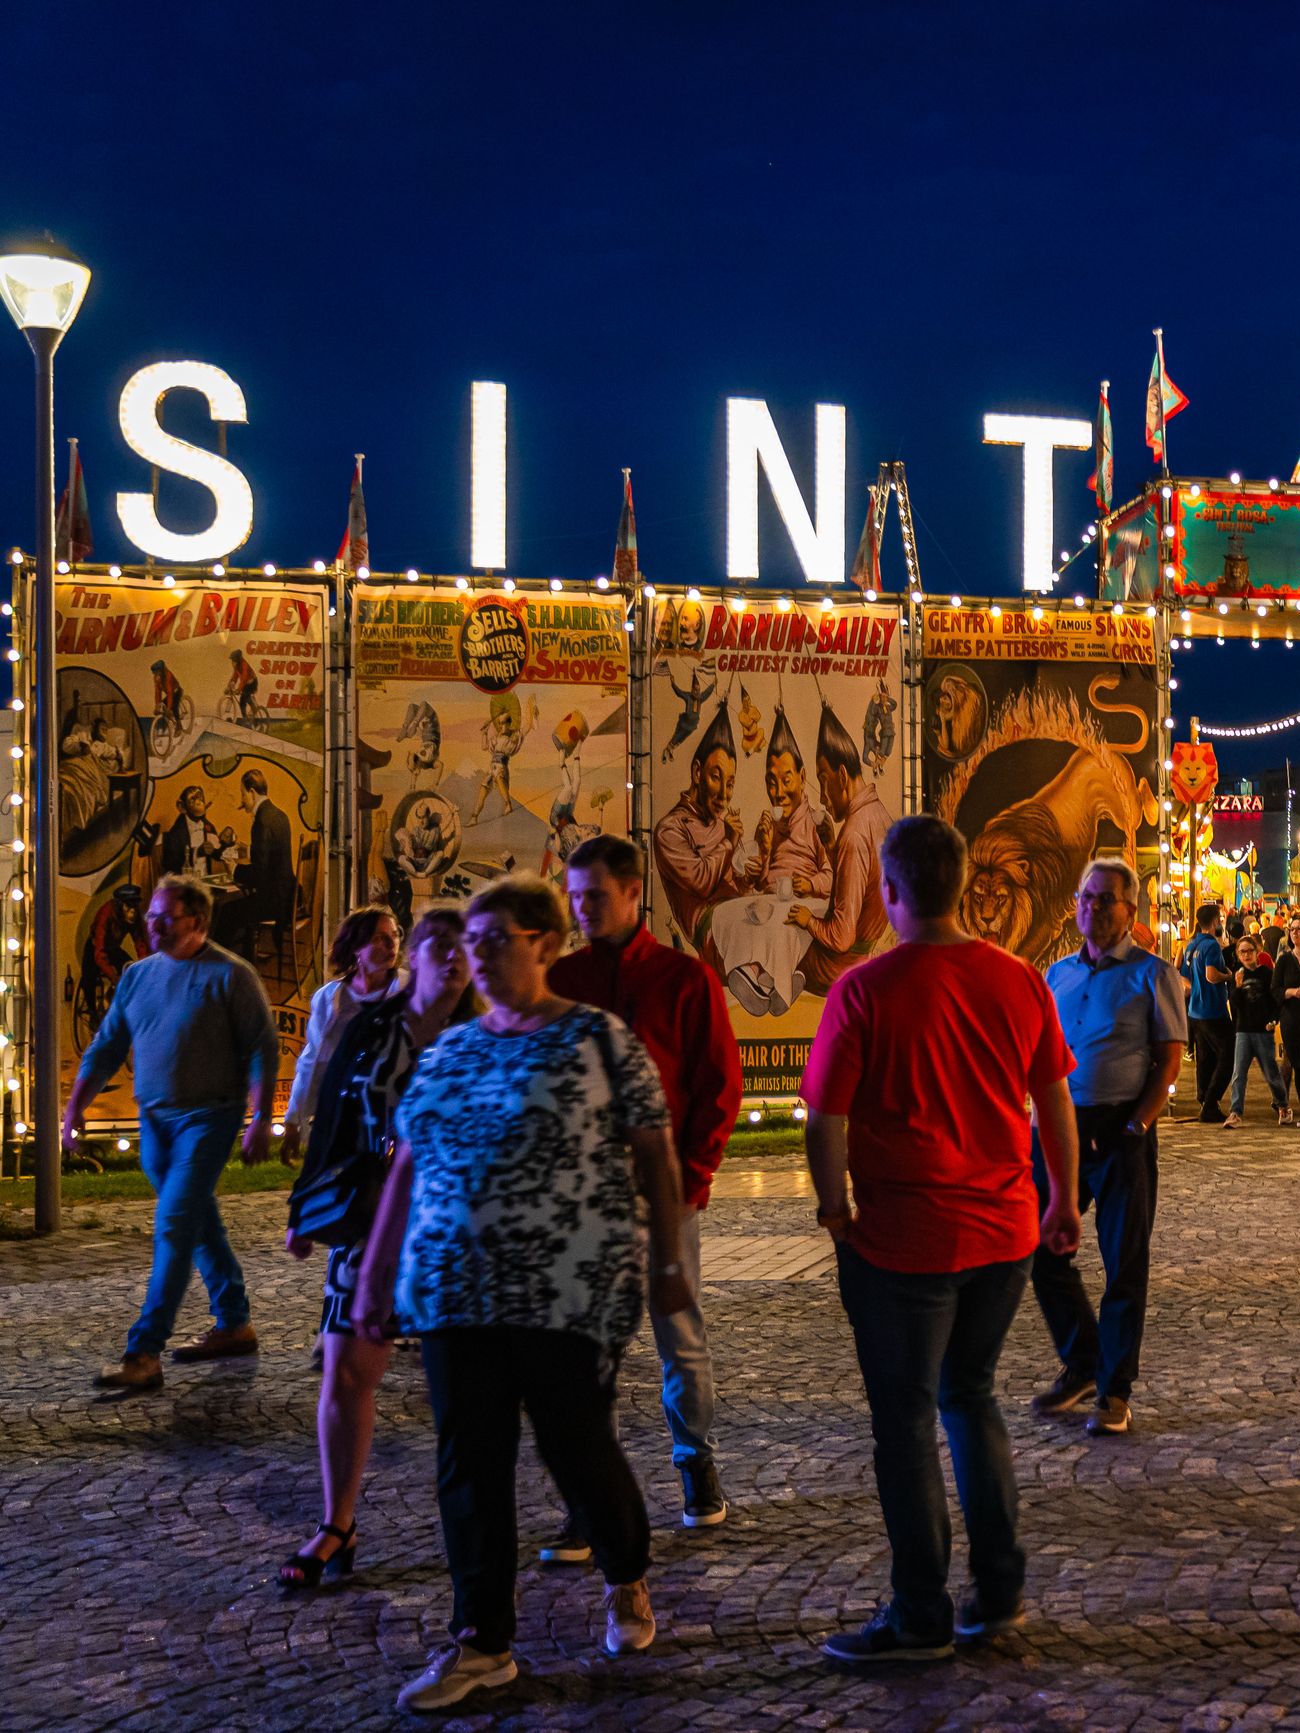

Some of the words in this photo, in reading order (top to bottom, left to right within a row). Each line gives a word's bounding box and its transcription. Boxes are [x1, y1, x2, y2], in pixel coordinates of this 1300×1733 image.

[117, 360, 1093, 592] SINT
[71, 586, 112, 609] THE
[193, 592, 318, 637] BAILEY
[467, 610, 518, 642] SELLS
[928, 611, 994, 634] GENTRY
[1002, 613, 1054, 635] BROS.
[1056, 618, 1092, 631] FAMOUS
[1095, 615, 1151, 640] SHOWS
[704, 605, 806, 652] BARNUM
[815, 611, 898, 657] BAILEY
[246, 640, 321, 657] GREATEST
[464, 634, 526, 660] BROTHERS
[531, 631, 561, 655] NEW
[559, 635, 622, 658] MONSTER
[928, 638, 973, 657] JAMES
[975, 639, 1068, 659] PATTERSON'S
[1111, 643, 1153, 662] CIRCUS
[260, 659, 318, 676] SHOW
[467, 657, 520, 684] BARRETT
[525, 650, 626, 681] SHOWS
[717, 653, 790, 674] GREATEST
[790, 656, 833, 676] SHOW
[844, 658, 889, 678] EARTH
[275, 679, 296, 690] ON
[771, 1045, 787, 1067] OF
[788, 1044, 812, 1067] THE
[753, 1075, 780, 1091] ARTISTS
